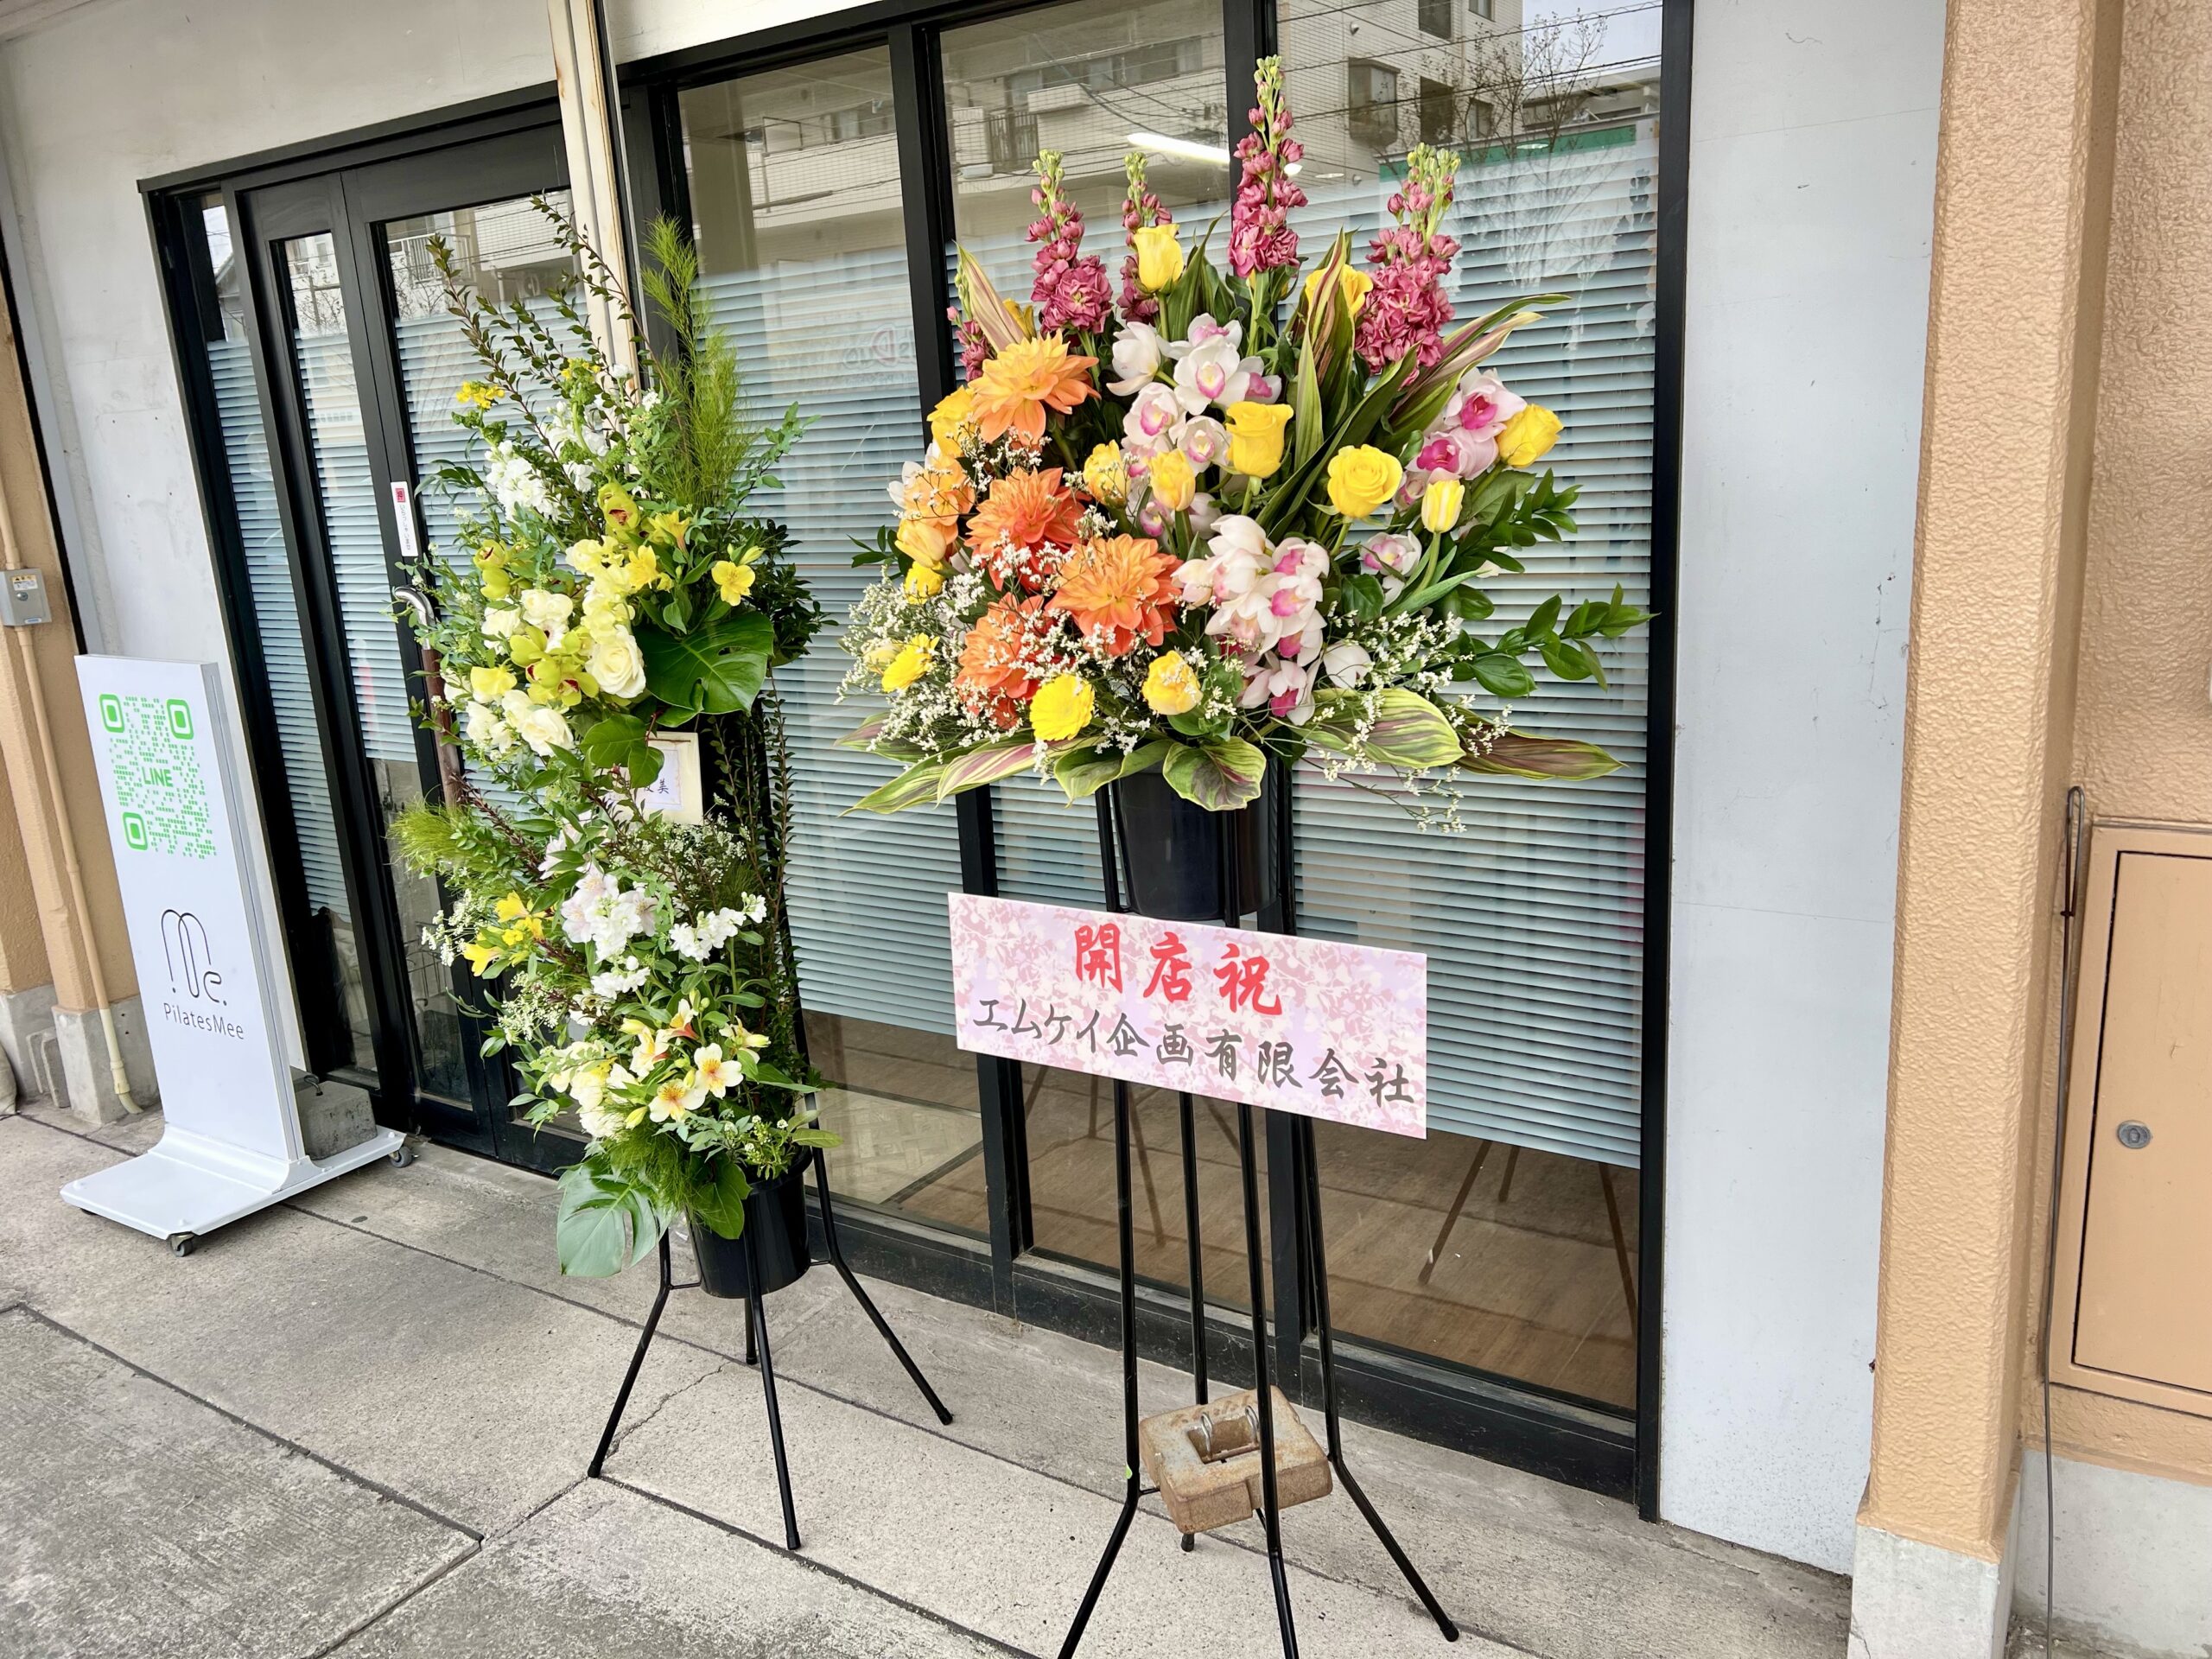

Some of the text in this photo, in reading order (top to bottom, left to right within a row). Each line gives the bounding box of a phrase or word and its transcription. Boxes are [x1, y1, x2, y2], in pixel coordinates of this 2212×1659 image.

[142, 766, 174, 787] LINE
[1074, 923, 1282, 1015] 開店祝
[163, 1002, 245, 1040] PilatesMee
[973, 998, 1414, 1108] エムケイ企画有限会社
